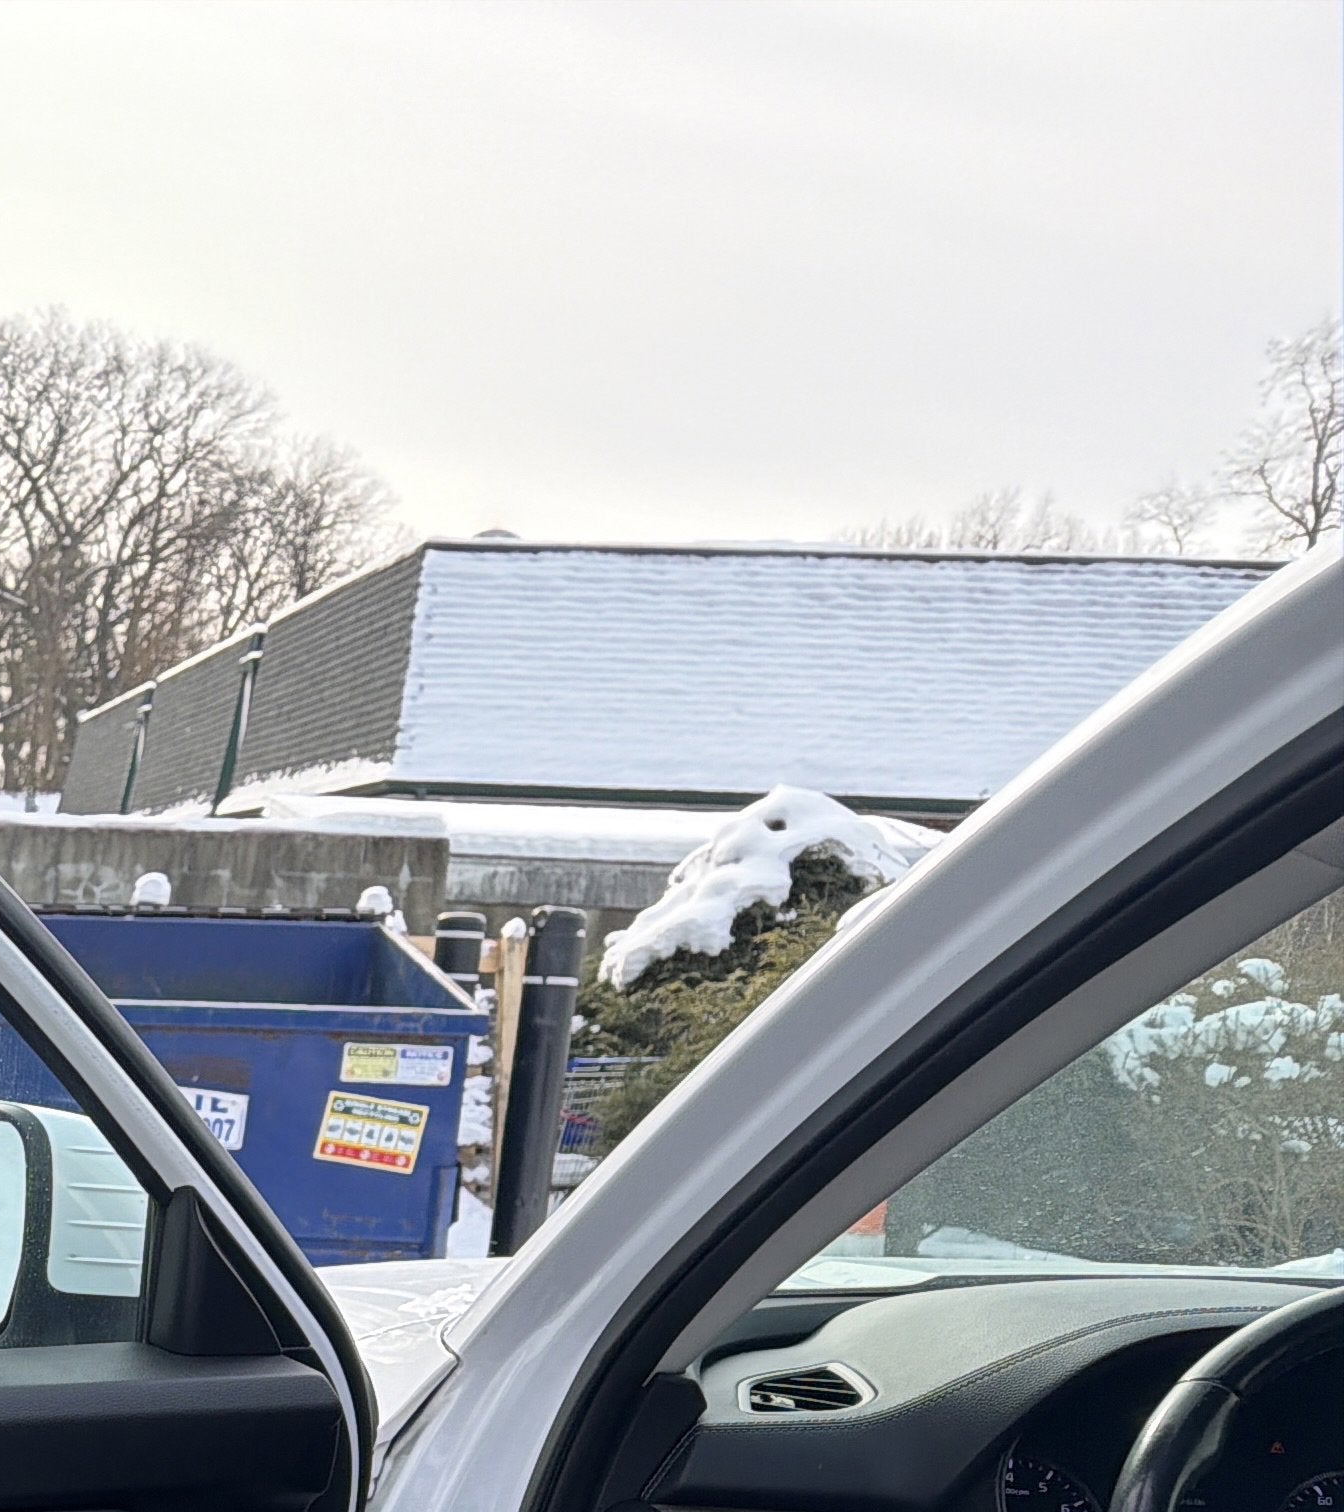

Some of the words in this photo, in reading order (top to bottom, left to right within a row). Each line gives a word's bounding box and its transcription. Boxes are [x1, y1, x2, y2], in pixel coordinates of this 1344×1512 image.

[203, 1117, 235, 1141] 07
[1005, 1472, 1014, 1483] 4
[1038, 1481, 1048, 1493] 5
[1317, 1496, 1333, 1506] 60
